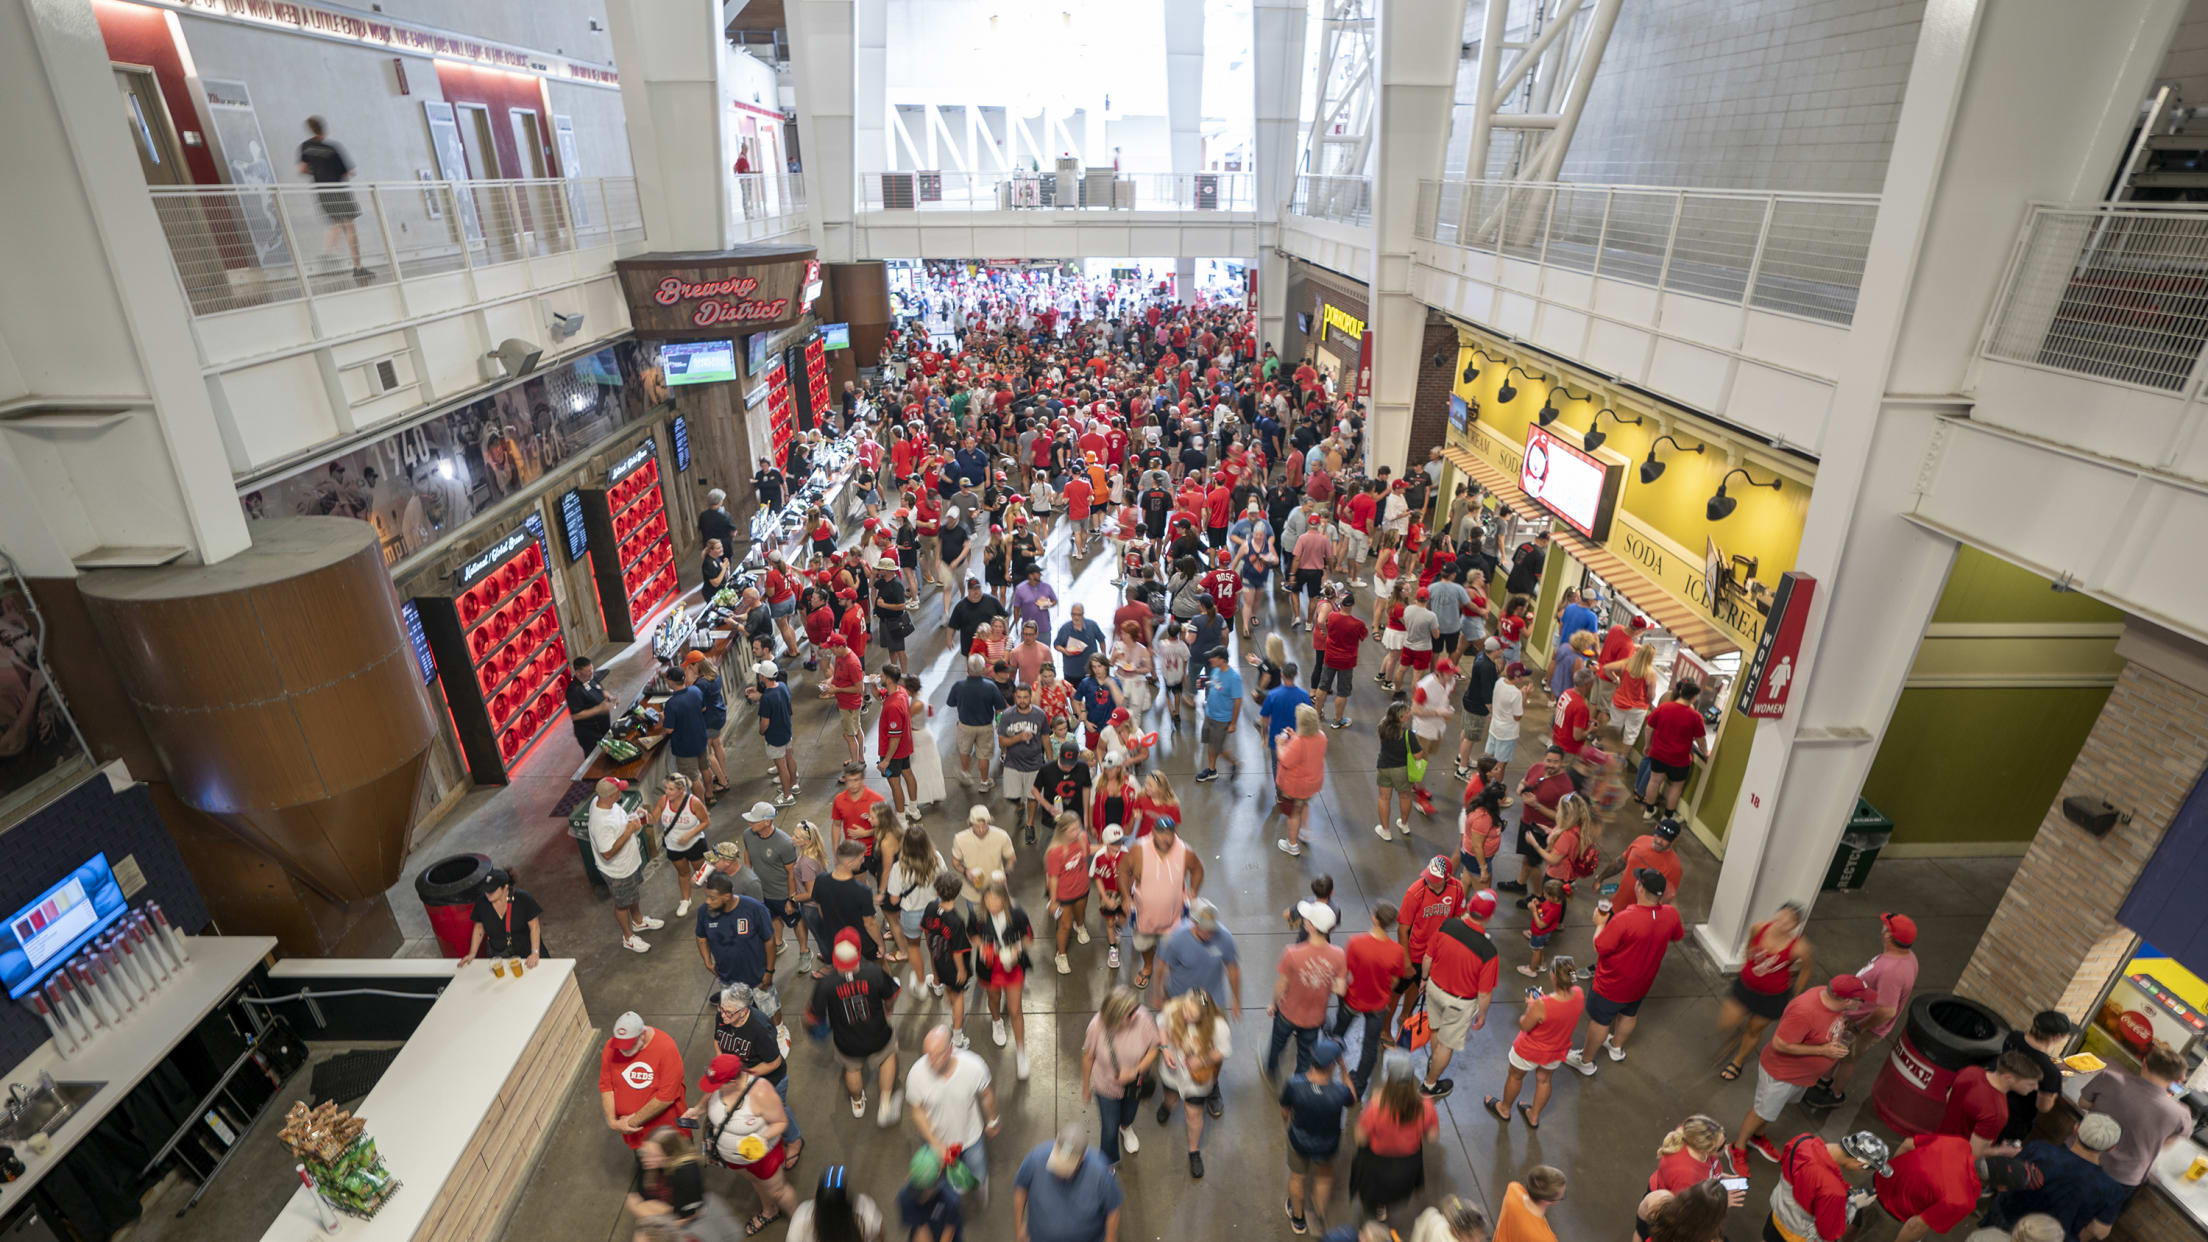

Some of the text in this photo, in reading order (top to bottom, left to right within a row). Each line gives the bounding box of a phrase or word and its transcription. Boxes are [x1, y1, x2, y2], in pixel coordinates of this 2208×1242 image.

[656, 276, 757, 305] Brewery
[693, 299, 788, 327] District
[373, 424, 430, 481] 1940
[1498, 450, 1520, 476] SOD
[1623, 533, 1663, 576] SODA
[1216, 572, 1235, 583] ROSE
[1217, 583, 1233, 598] 14
[1741, 632, 1773, 708] WOMEN
[1753, 703, 1785, 714] WOMEN
[1055, 780, 1076, 797] C
[1750, 793, 1760, 808] 18
[630, 1071, 654, 1081] REDS
